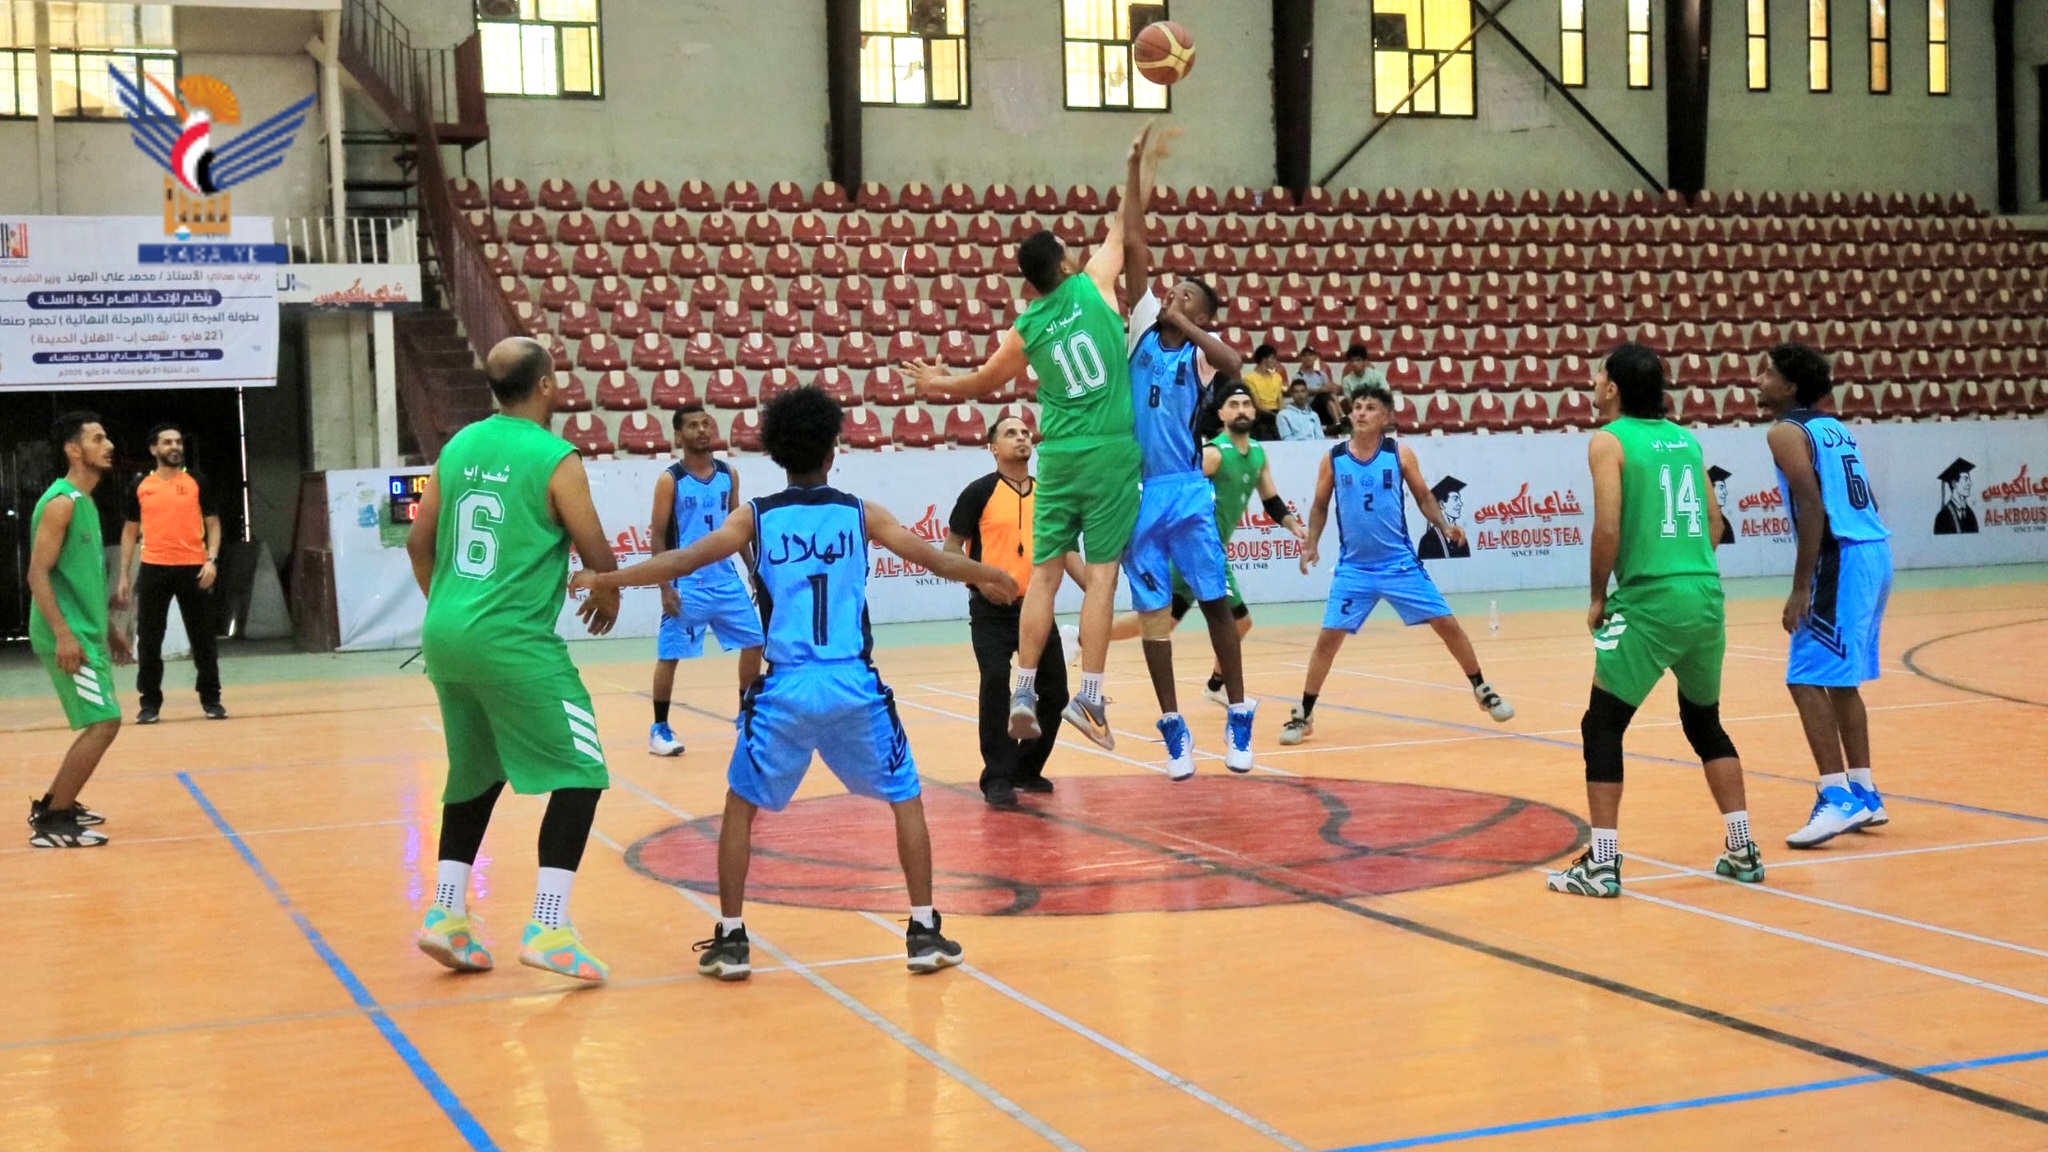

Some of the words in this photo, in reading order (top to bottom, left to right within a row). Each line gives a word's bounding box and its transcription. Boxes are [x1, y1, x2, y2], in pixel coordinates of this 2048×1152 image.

[66, 271, 98, 284] المولد
[101, 271, 125, 284] علي
[37, 293, 75, 306] السلة
[76, 293, 104, 307] لكرة
[105, 293, 139, 307] العام
[28, 317, 57, 328] تجمع
[156, 312, 189, 326] الثانية
[192, 312, 225, 325] الدرجة
[228, 312, 260, 324] بطولة
[1059, 302, 1082, 328] شعب
[80, 332, 114, 345] الهلال
[204, 330, 217, 340] 22
[1051, 329, 1108, 399] 10
[1149, 384, 1162, 409] 8
[1664, 434, 1689, 452] شعب
[481, 465, 510, 484] شعب
[1841, 454, 1870, 511] 6
[1982, 464, 2032, 503] الكبوس
[392, 481, 402, 495] 0
[1363, 493, 1374, 512] 2
[1474, 482, 1534, 525] الكبوس
[1533, 489, 1584, 522] شاي
[1659, 464, 1703, 538] 14
[704, 514, 714, 532] 4
[1984, 506, 2048, 526] AL-KBOUS
[453, 488, 506, 581] 6
[1741, 517, 1791, 537] AL-KBO
[768, 528, 854, 566] الهلال
[1511, 549, 1534, 558] SINCE
[1231, 563, 1250, 571] INCE
[1253, 562, 1269, 570] 1948
[806, 572, 829, 647] 1
[1341, 598, 1353, 615] 2
